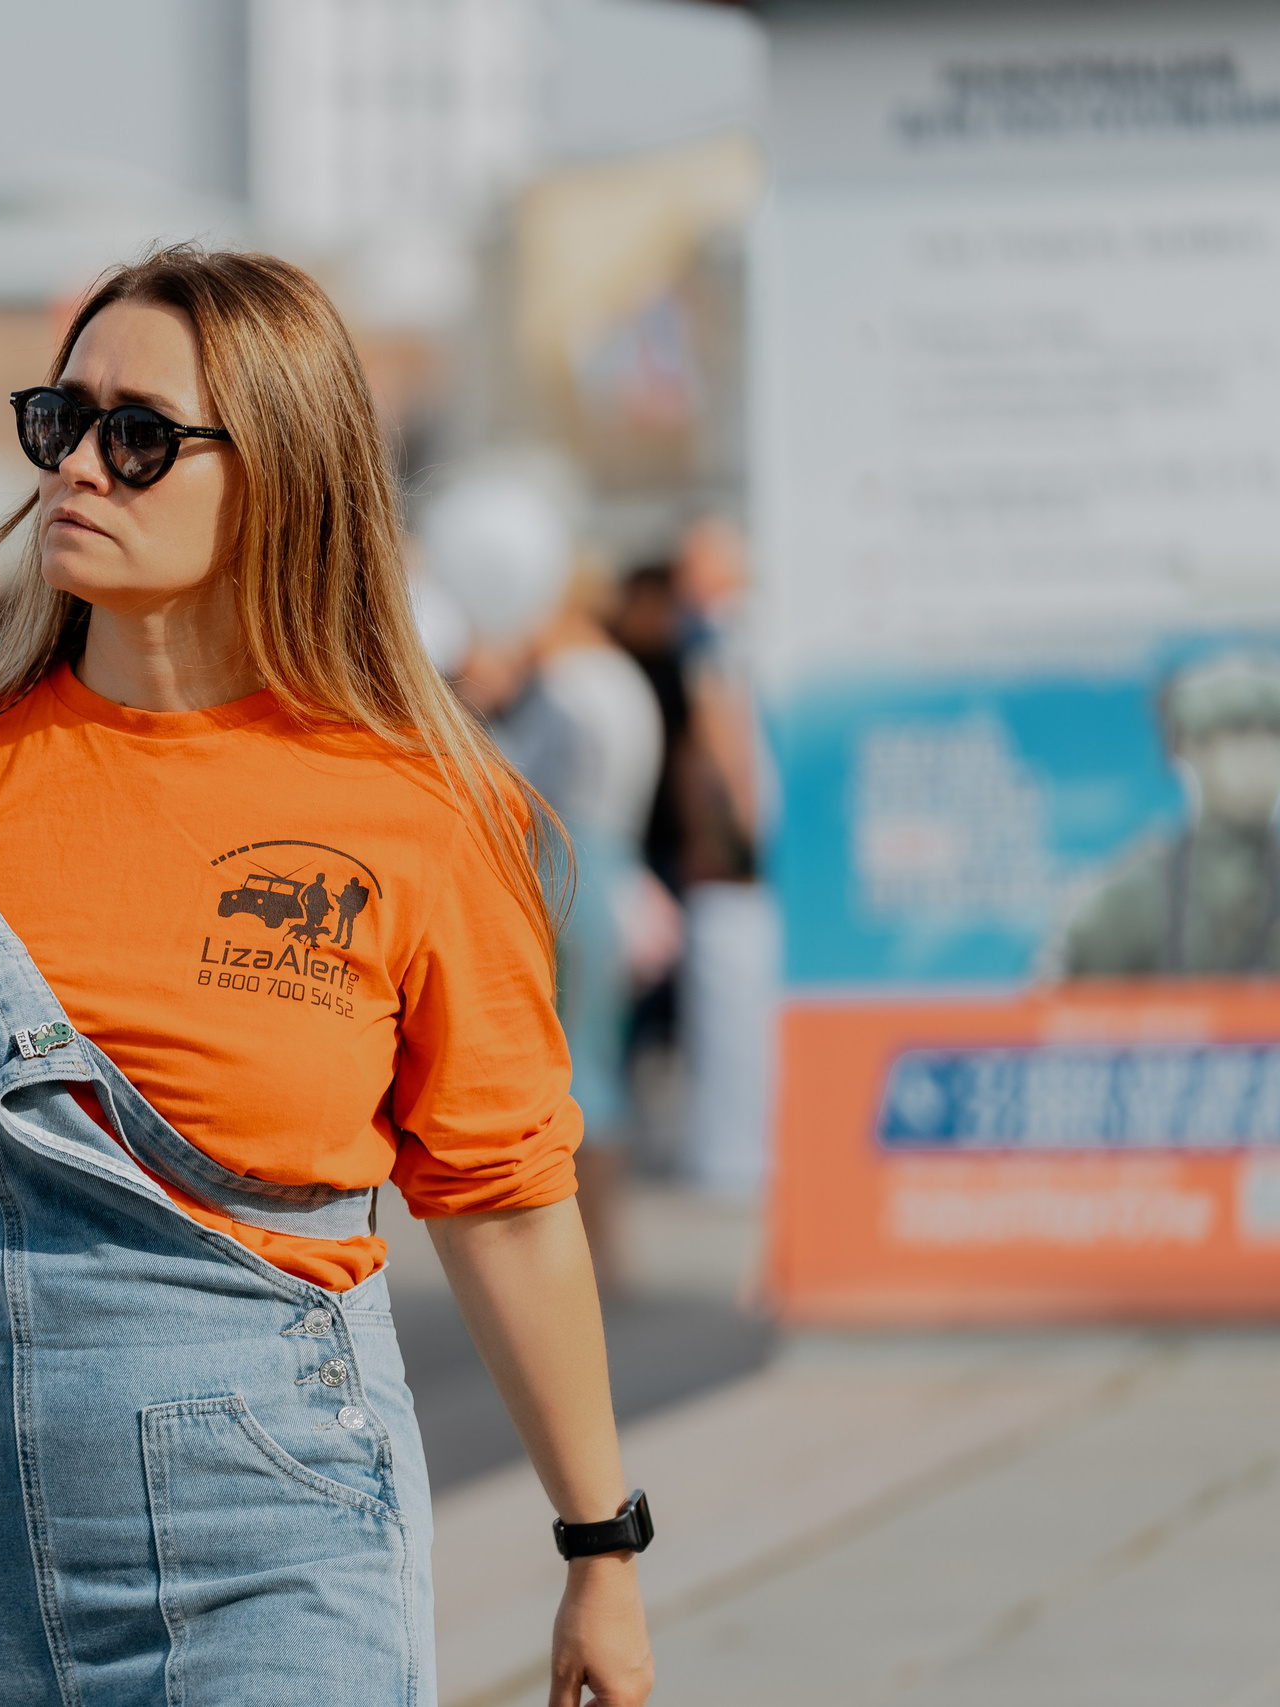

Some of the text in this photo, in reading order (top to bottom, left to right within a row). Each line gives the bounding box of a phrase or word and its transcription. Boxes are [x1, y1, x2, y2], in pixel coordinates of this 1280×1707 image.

[200, 936, 350, 989] LizaAlert
[197, 969, 355, 1019] 8 800 700 54 52
